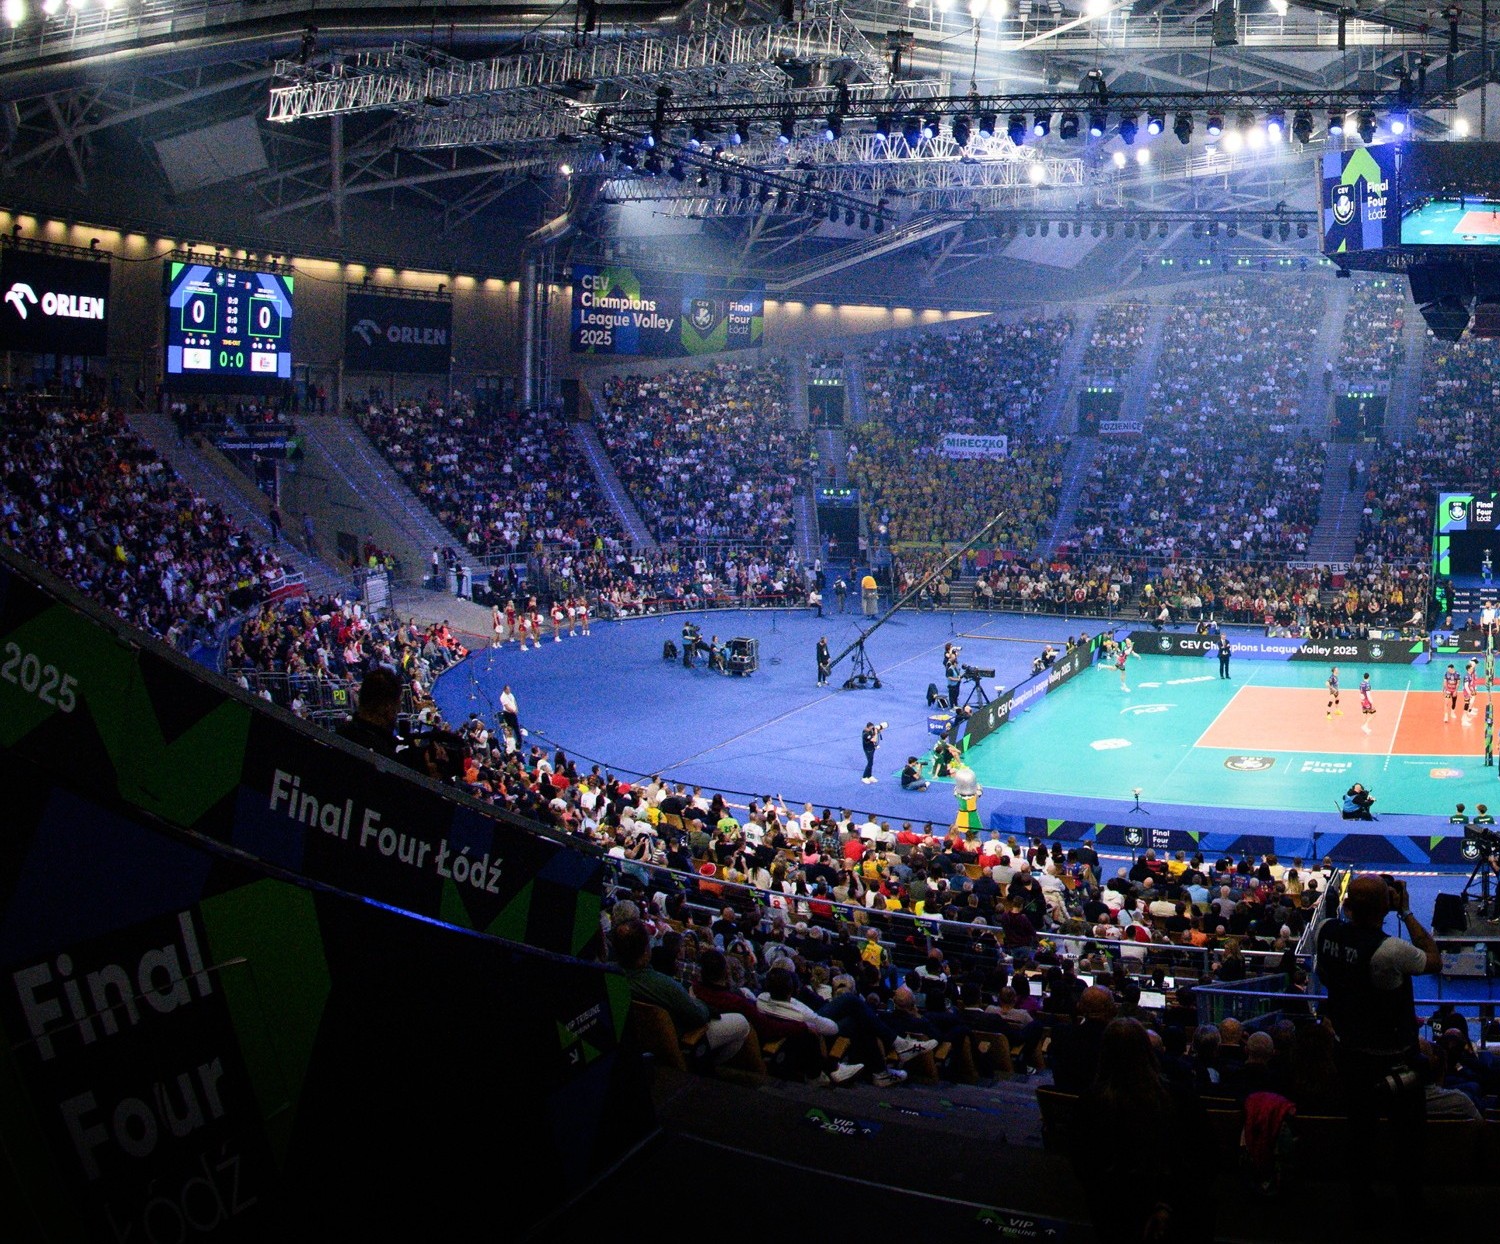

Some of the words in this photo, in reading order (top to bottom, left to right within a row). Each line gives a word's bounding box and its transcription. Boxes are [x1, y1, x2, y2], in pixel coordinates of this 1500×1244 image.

[1366, 180, 1389, 193] Final
[1367, 196, 1388, 208] Four
[1367, 208, 1387, 221] Łódź
[581, 275, 610, 290] CEV
[42, 292, 104, 320] ORLEN
[581, 292, 656, 312] Champions
[729, 302, 753, 313] Final
[192, 300, 206, 323] 0
[259, 306, 271, 329] 0
[580, 310, 630, 329] League
[632, 313, 674, 332] Volley
[729, 314, 751, 324] Four
[386, 327, 447, 346] ORLEN
[580, 330, 612, 345] 2025
[223, 442, 250, 450] Champions
[250, 442, 269, 450] League
[945, 438, 1004, 448] MIRECZKO
[1180, 640, 1201, 650] CEV
[1202, 640, 1258, 653] Chpions
[1260, 643, 1298, 655] League
[1300, 645, 1331, 656] Volley
[1333, 646, 1358, 655] 2025
[1, 641, 79, 714] 2025
[997, 702, 1008, 718] CEV
[1008, 689, 1033, 710] Champions
[1033, 679, 1049, 694] League
[1048, 670, 1061, 684] Volley
[1061, 662, 1071, 676] 2025
[1303, 760, 1353, 768] Final
[269, 768, 352, 841] Final
[358, 808, 432, 869] Four
[437, 841, 503, 895] Łódź
[1152, 829, 1170, 837] Final
[1152, 836, 1169, 844] Four
[12, 909, 215, 1062] Final
[56, 1053, 227, 1183] Four
[833, 1117, 855, 1127] VIP
[820, 1122, 857, 1135] ZONE
[1009, 1218, 1035, 1228] VIP
[997, 1225, 1037, 1237] TRIBUNE
